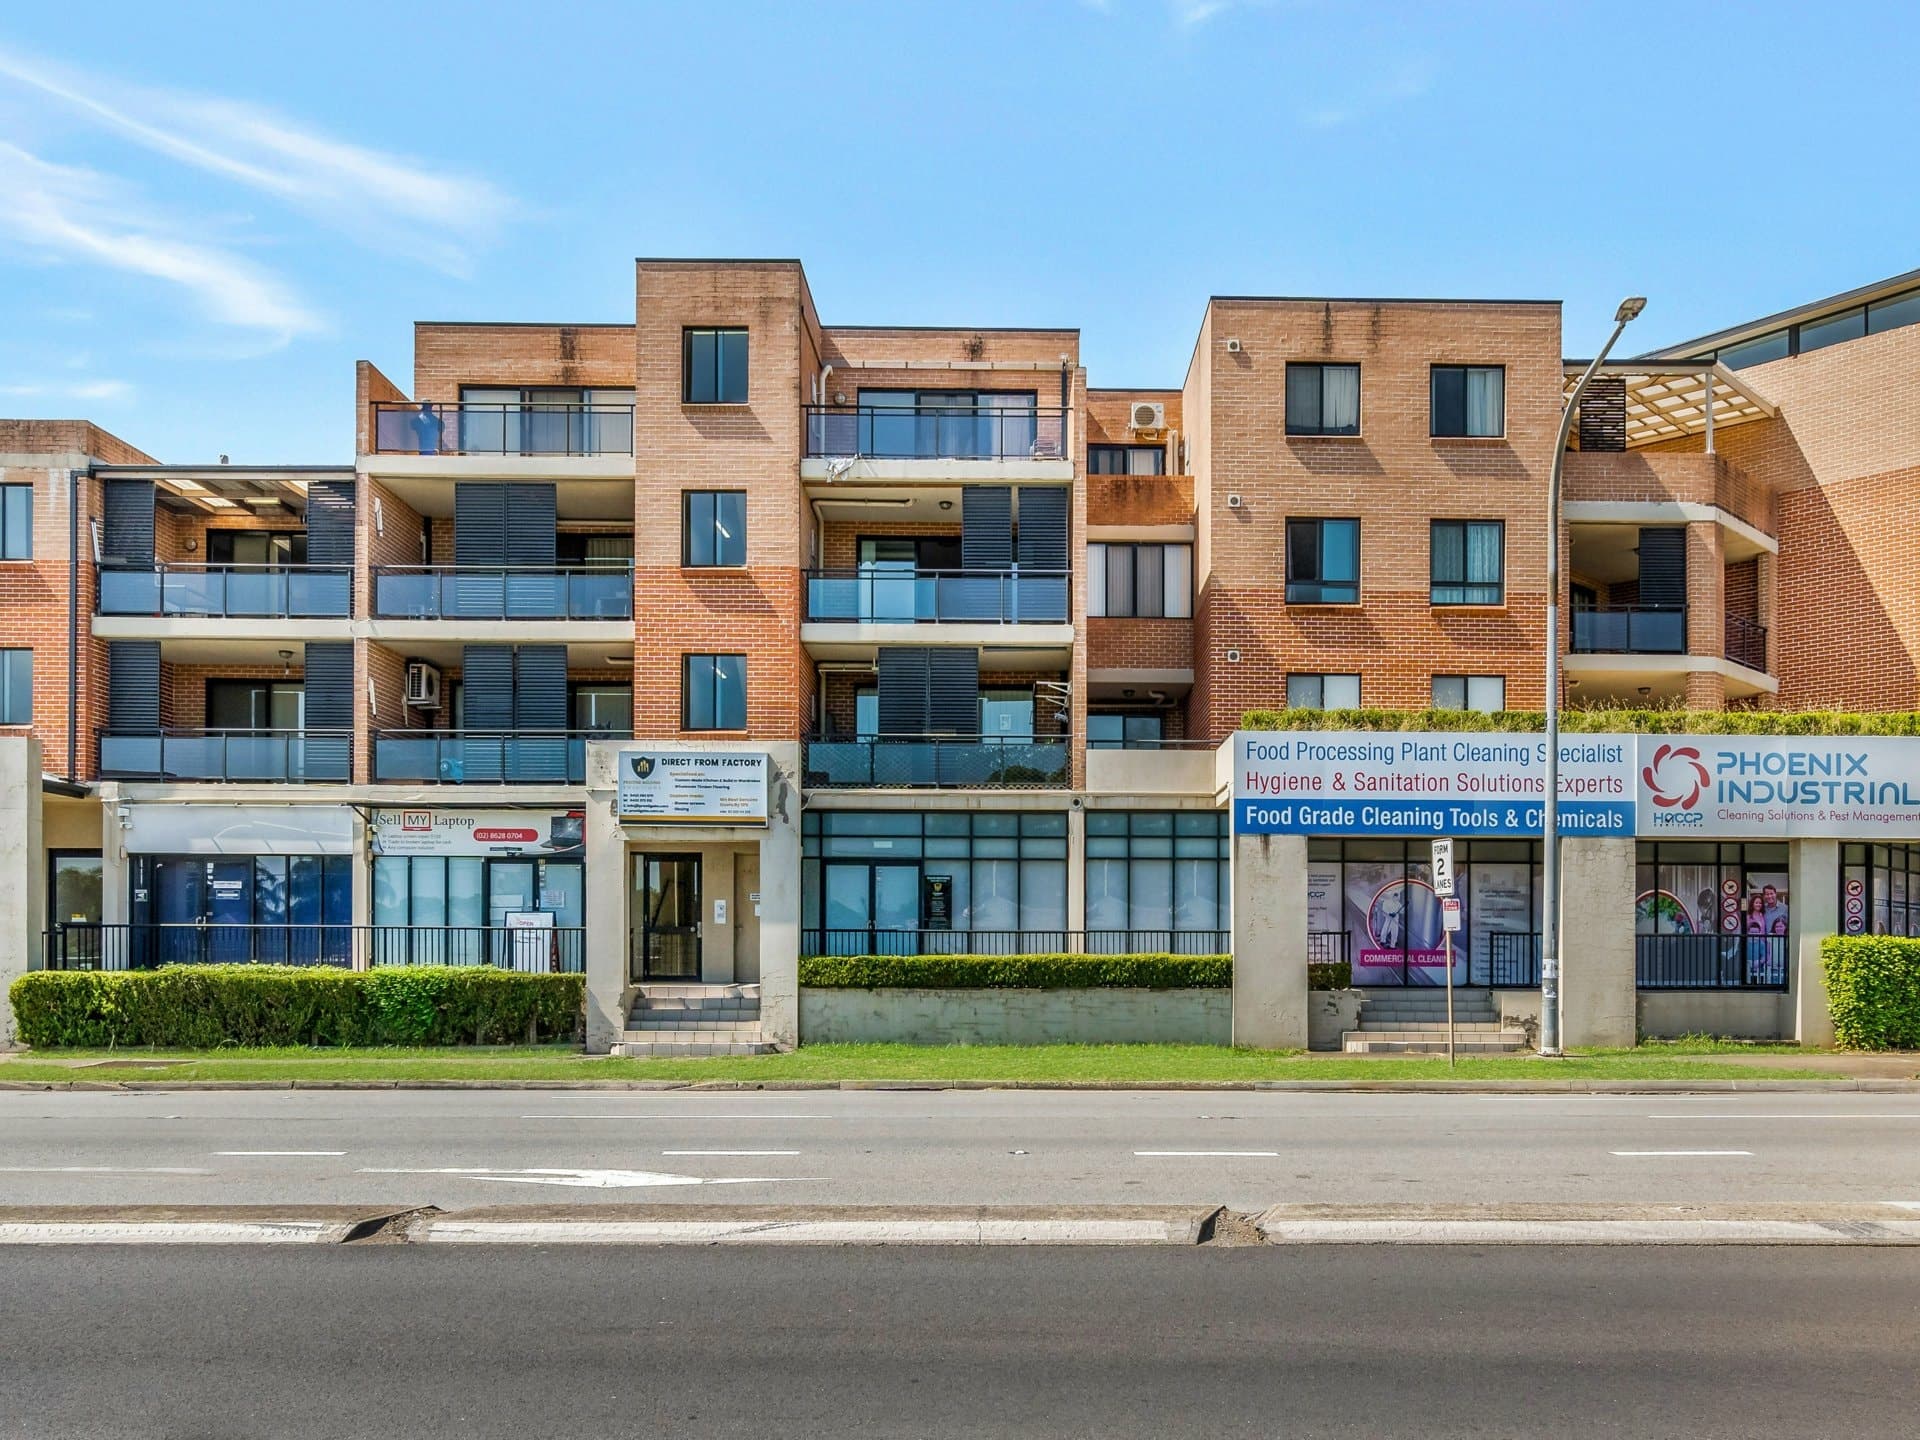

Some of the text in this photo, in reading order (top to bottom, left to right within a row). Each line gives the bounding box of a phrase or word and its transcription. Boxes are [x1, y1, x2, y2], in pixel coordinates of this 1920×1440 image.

[661, 758, 762, 767] DIRECT FROM FACTORY
[1246, 741, 1623, 766] Food Processing Plant Cleaning Secialist
[1717, 751, 1869, 776] PHOENIX
[1246, 771, 1322, 795] Hygiene
[1332, 772, 1346, 791] &
[1354, 772, 1449, 792] Sanitation
[1457, 772, 1544, 792] Solutions
[1717, 780, 1920, 805] INDUSTRIAL
[380, 814, 475, 829] Sell MY Laptop
[1246, 805, 1292, 825] Food
[1299, 806, 1355, 825] Grade
[1361, 806, 1444, 830] Cleaning
[1449, 808, 1498, 827] Tools
[1505, 809, 1519, 827] &
[1717, 809, 1764, 823] Cleaning
[1768, 810, 1815, 821] Solutions
[1819, 811, 1827, 821] &
[1830, 811, 1849, 821] Pest
[1434, 844, 1449, 855] FORM
[1437, 857, 1445, 876] 2
